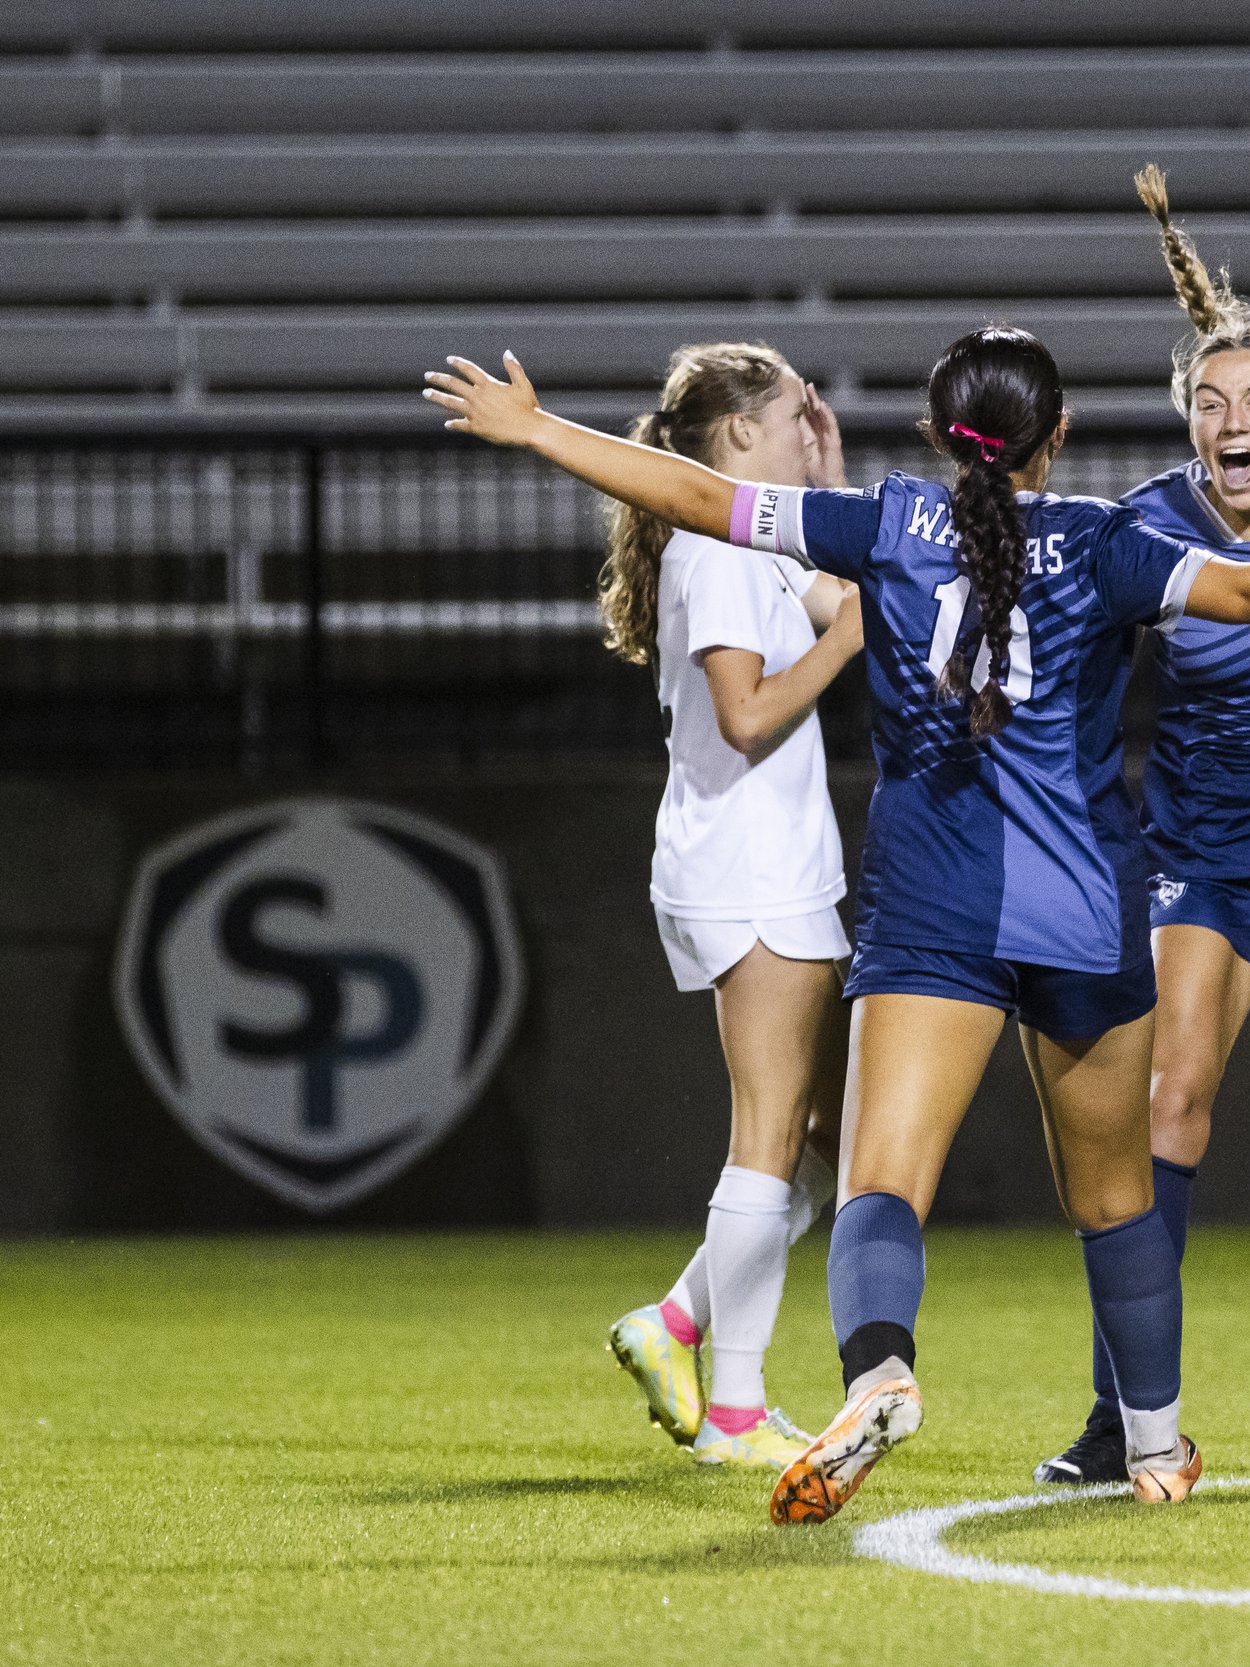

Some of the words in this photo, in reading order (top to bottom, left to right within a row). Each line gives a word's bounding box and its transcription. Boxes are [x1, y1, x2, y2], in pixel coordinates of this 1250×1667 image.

[757, 488, 780, 536] APTAIN
[922, 574, 1033, 706] 10
[219, 876, 425, 1132] SP
